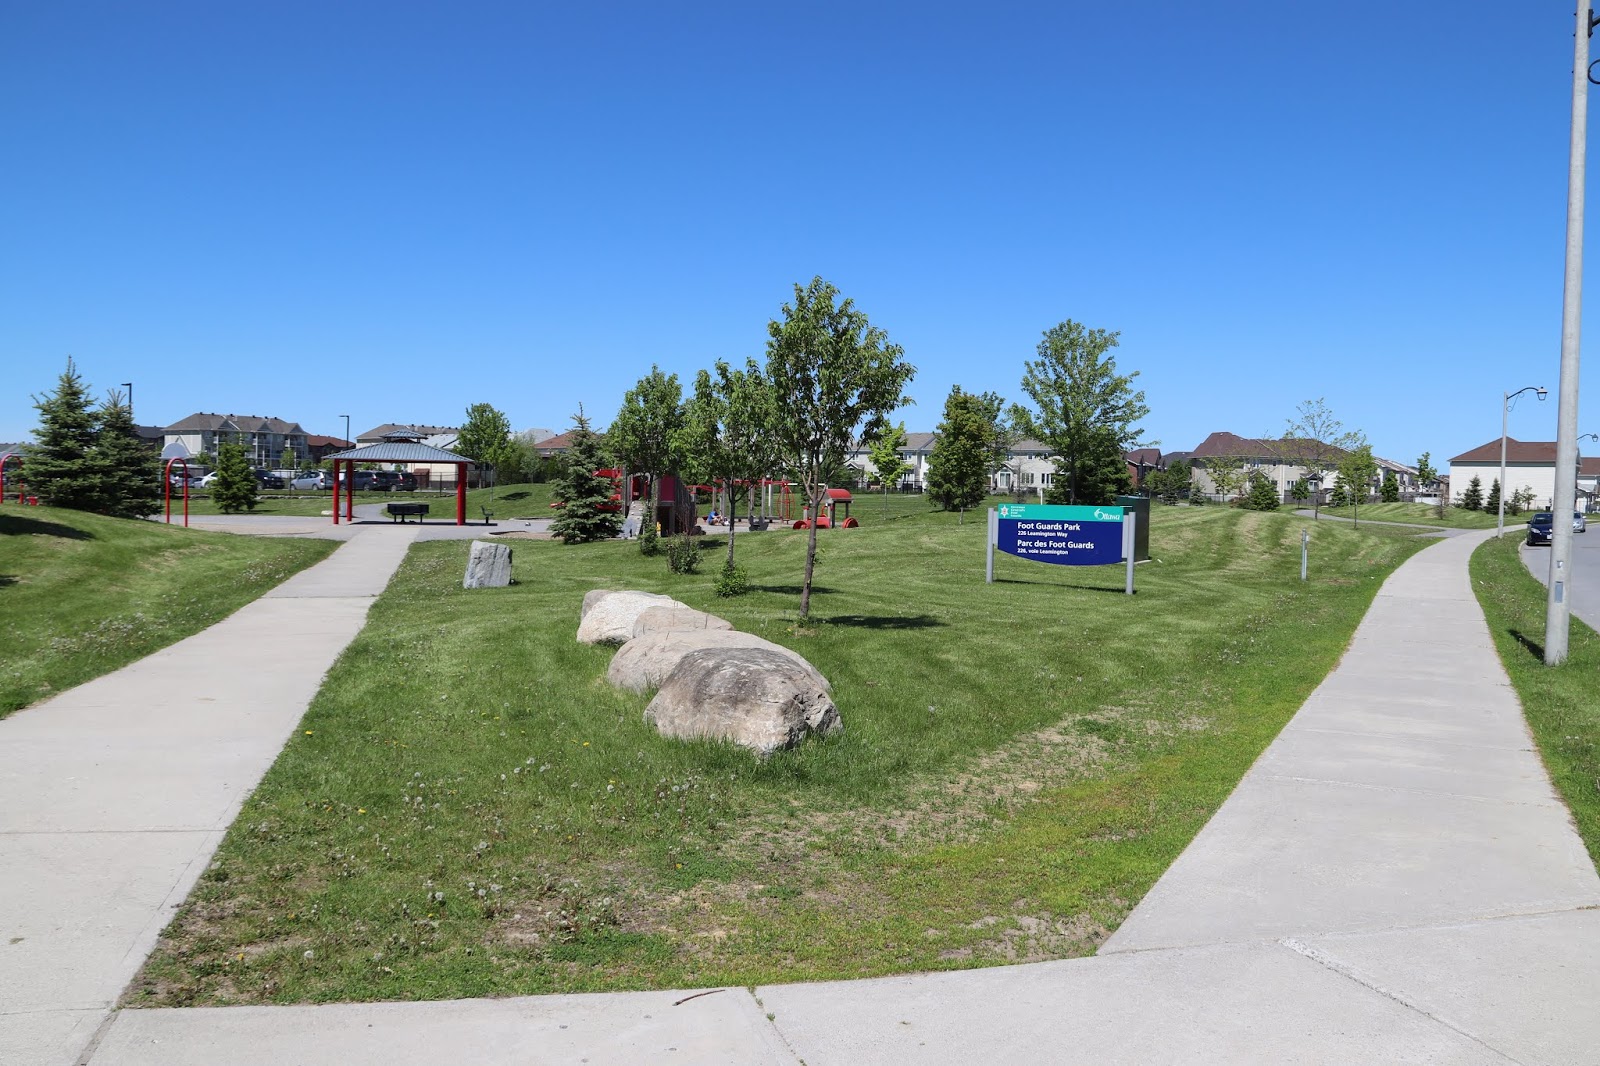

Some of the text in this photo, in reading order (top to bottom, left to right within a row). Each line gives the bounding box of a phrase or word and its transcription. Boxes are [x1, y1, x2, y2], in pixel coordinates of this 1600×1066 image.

[1018, 522, 1034, 530] Foot
[1064, 523, 1080, 531] Park
[1017, 539, 1033, 547] Parc
[1049, 540, 1066, 548] Foot
[1067, 541, 1094, 549] Guards
